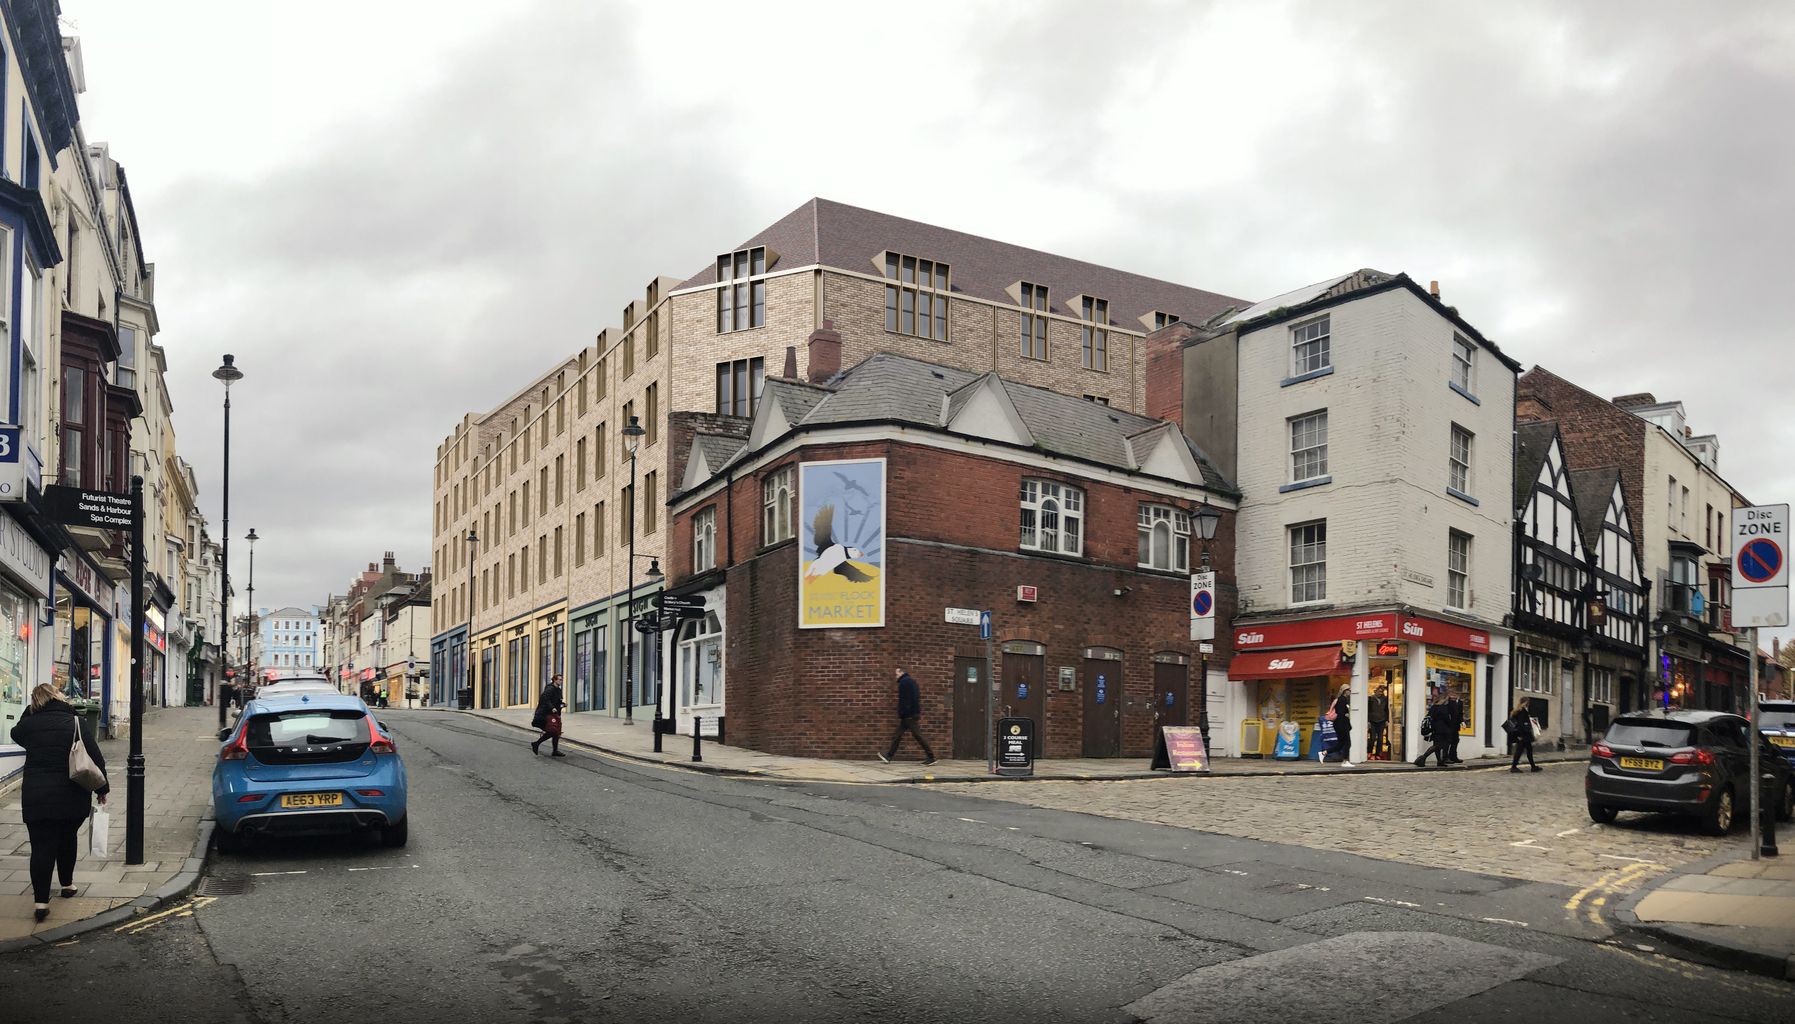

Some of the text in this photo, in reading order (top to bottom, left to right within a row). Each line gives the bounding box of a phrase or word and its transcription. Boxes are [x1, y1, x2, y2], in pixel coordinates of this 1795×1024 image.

[82, 492, 131, 505] Futurist Theatre
[78, 502, 99, 512] Sands
[106, 506, 131, 515] Harbour
[1747, 510, 1773, 520] Disc
[90, 514, 131, 525] Spa Complex
[1739, 522, 1782, 535] ZONE
[10, 521, 44, 580] STUDIO
[1193, 580, 1212, 590] ZONE
[633, 598, 648, 614] SIGN
[808, 604, 875, 619] MARKET
[286, 793, 339, 806] AE63 YRP
